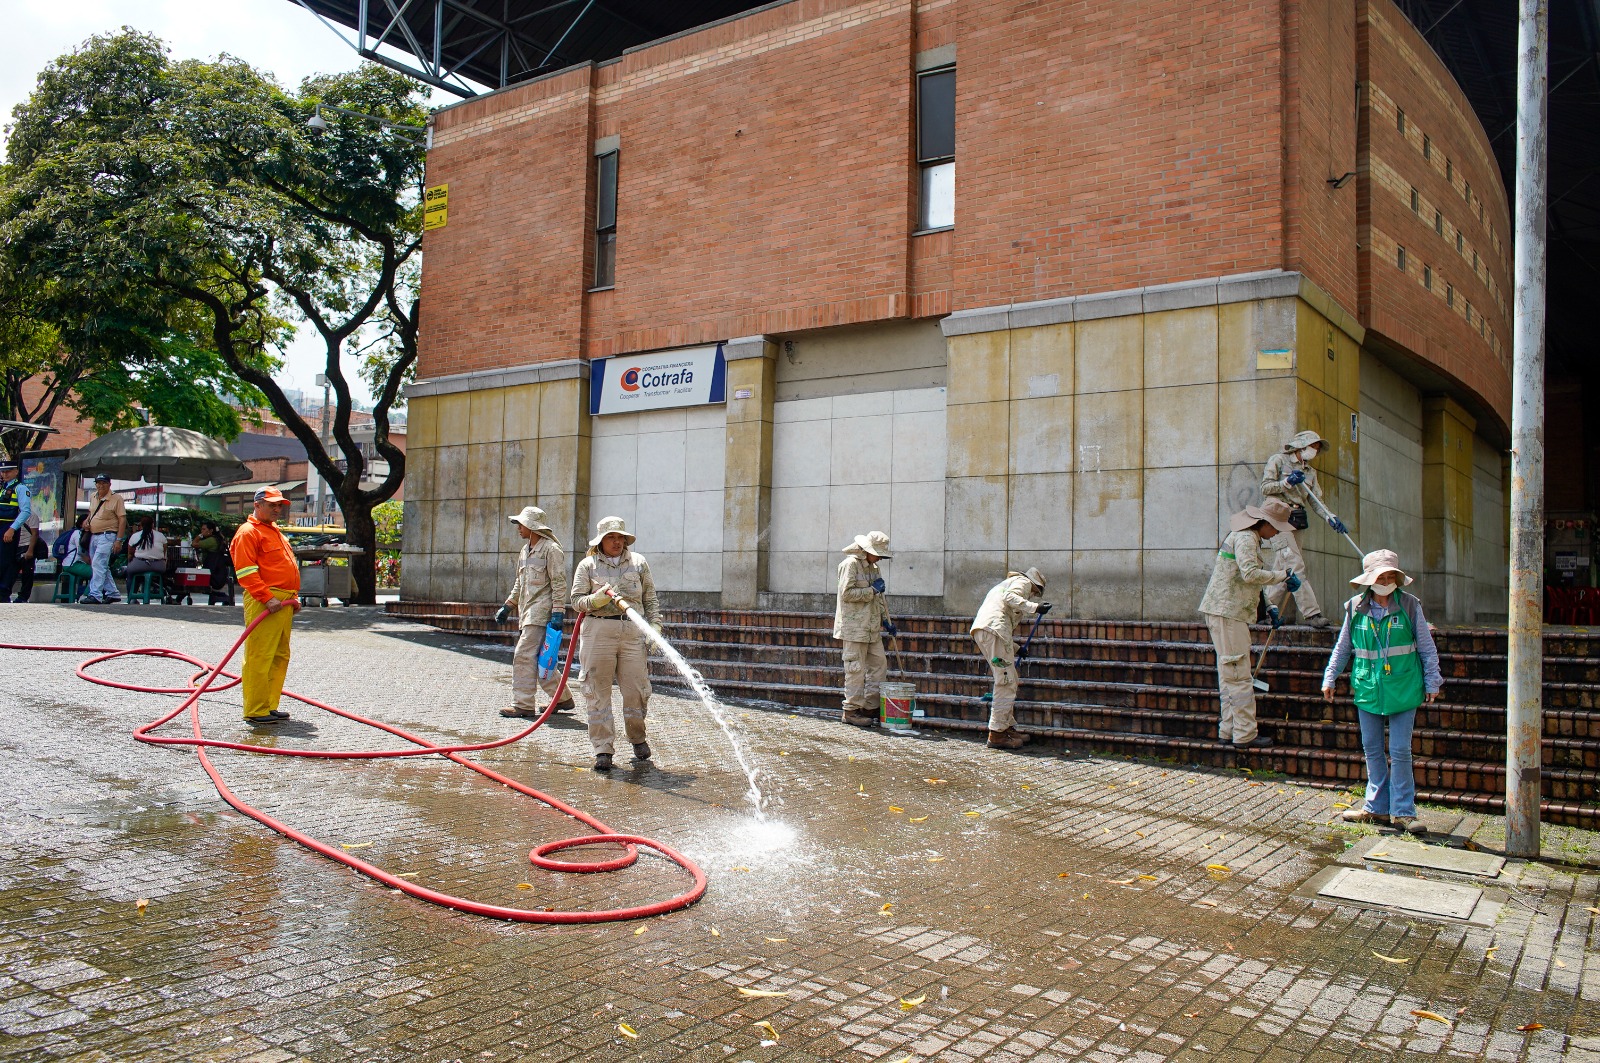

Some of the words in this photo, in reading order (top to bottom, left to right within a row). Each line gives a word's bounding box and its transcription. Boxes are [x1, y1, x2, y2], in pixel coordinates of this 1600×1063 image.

[642, 364, 669, 372] COOPERATIVA
[642, 369, 694, 388] Cotrafa
[296, 514, 335, 527] PANADÍA
